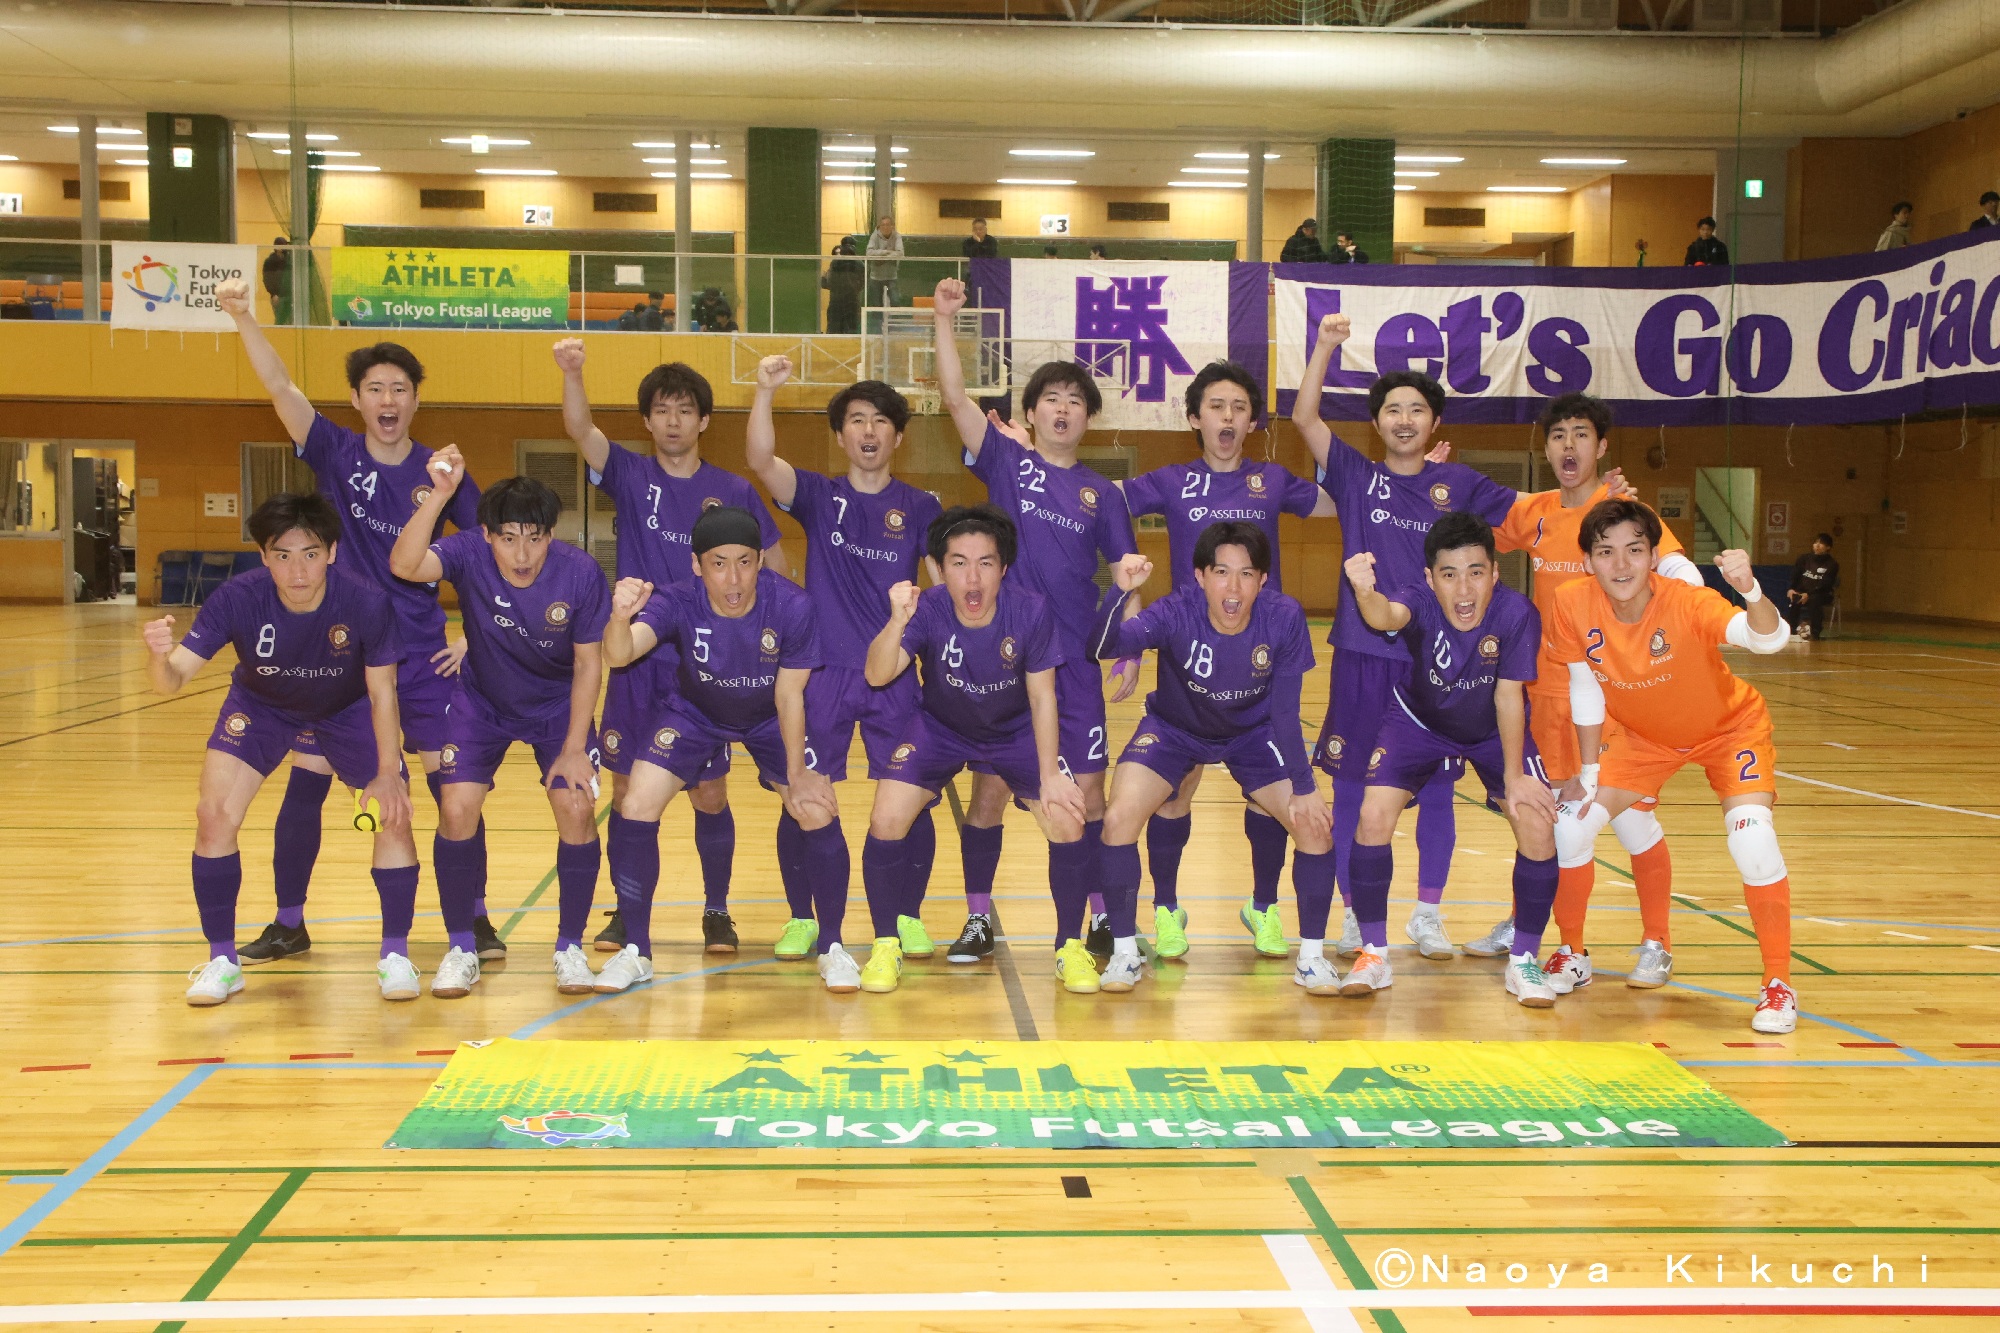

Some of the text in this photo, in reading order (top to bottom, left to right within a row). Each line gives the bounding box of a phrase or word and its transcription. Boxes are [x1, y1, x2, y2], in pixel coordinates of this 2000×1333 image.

[12, 198, 17, 212] 1
[525, 210, 535, 223] 2
[1057, 219, 1067, 232] 3
[188, 264, 242, 282] Tokyo
[190, 281, 217, 295] Fut
[185, 294, 224, 311] Leag
[382, 301, 552, 321] Tokyo Futsal League
[1075, 276, 1196, 402] 勝
[1305, 288, 1592, 398] Let's
[1635, 294, 1793, 398] Go
[1018, 459, 1046, 492] 22
[1181, 472, 1211, 499] 21
[1367, 471, 1391, 500] 15
[833, 496, 848, 525] 7
[1034, 508, 1085, 534] ASSETLEAD
[1209, 509, 1266, 520] ASSETLEAD
[364, 517, 404, 536] ASSETLE
[1533, 517, 1545, 548] 1
[845, 543, 898, 562] ASSETLEAD
[1543, 561, 1586, 573] ASSETLEA
[256, 624, 276, 658] 8
[693, 628, 713, 663] 5
[1586, 628, 1605, 664] 2
[1183, 640, 1213, 678] 18
[1650, 654, 1674, 666] Futsal
[714, 676, 775, 687] ASSETLEAD
[649, 747, 670, 758] Futsal
[1088, 726, 1109, 760] 2
[1736, 749, 1761, 782] 2
[696, 1115, 1681, 1144] Tokyo Futsal League
